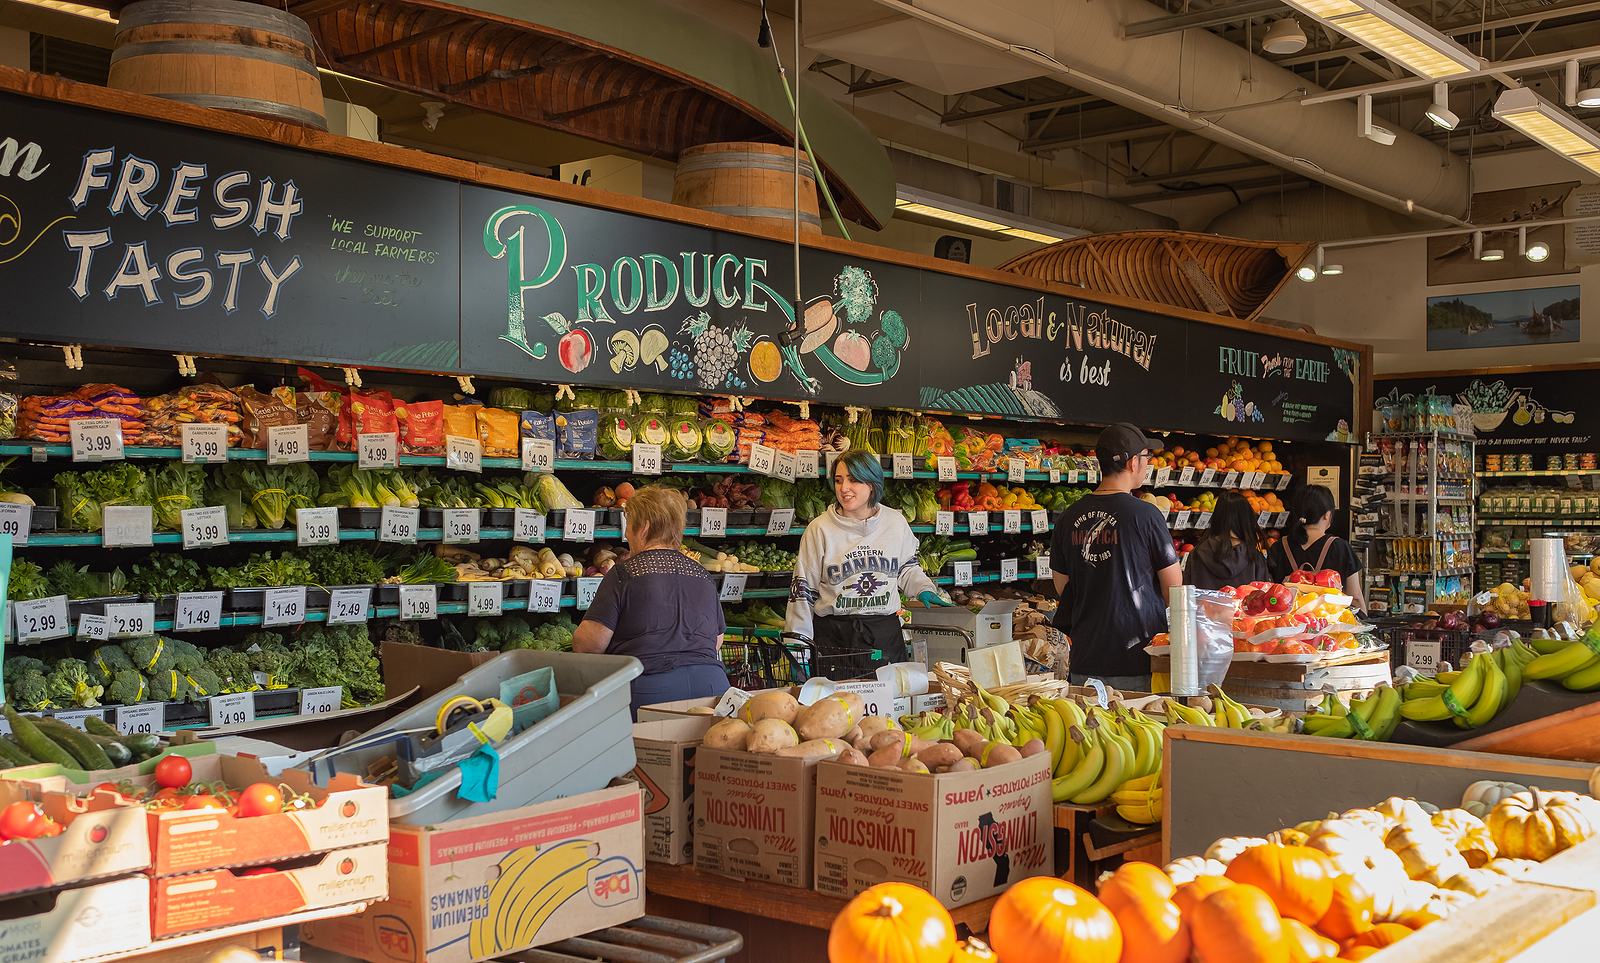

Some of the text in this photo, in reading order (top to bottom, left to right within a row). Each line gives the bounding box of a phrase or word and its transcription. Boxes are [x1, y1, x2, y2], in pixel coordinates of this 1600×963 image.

[70, 147, 303, 242] FRESH
[364, 224, 423, 243] SUPPORT
[331, 238, 369, 254] LOCAL
[63, 227, 303, 319] TASTY
[483, 204, 768, 360] PRODUCE
[965, 296, 1157, 371] Local & Natural
[1059, 355, 1111, 386] is best
[1220, 346, 1259, 378] FRUIT
[1296, 358, 1330, 383] EARTH
[81, 433, 111, 451] $3.99
[190, 438, 218, 456] $3.99
[274, 439, 299, 455] $4.99
[364, 446, 387, 461] $4.99
[453, 446, 474, 464] $4.99
[528, 451, 548, 467] $4.99
[638, 454, 656, 470] $4.99
[754, 454, 769, 470] $2.99
[778, 461, 792, 477] $2.99
[388, 519, 410, 537] $4.99
[450, 520, 471, 536] $3.99
[520, 520, 538, 537] $3.99
[569, 519, 587, 534] $2.99
[706, 517, 721, 531] $1.99
[772, 520, 786, 531] $3.99
[1073, 514, 1087, 529] KING
[1087, 511, 1096, 519] OF
[1097, 511, 1108, 519] THE
[190, 524, 219, 541] $3.99
[305, 522, 330, 539] $3.99
[844, 549, 884, 560] WESTERN
[827, 556, 900, 585] CANADA
[725, 583, 740, 596] $2.99
[407, 598, 430, 614] $1.99
[473, 594, 494, 611] $4.99
[535, 591, 554, 608] $3.99
[183, 607, 210, 624] $1.49
[272, 601, 297, 617] $1.49
[337, 601, 360, 617] $2.49
[24, 614, 56, 633] $2.99
[84, 623, 104, 636] $2.99
[114, 615, 143, 633] $2.99
[1411, 652, 1433, 665] $2.99
[697, 771, 797, 792] SWEET POTATOES yams
[945, 767, 1051, 806] SWEET POTATOES yams
[726, 788, 765, 805] Organic
[820, 786, 929, 812] SWEET POTATOES yams
[998, 793, 1031, 814] Organic
[582, 814, 609, 828] BANANAS
[610, 808, 635, 823] PREMIUM
[706, 797, 786, 834] LIVINGSTON
[853, 806, 895, 824] Organic
[320, 817, 378, 835] millennium
[515, 823, 577, 843] PREMIUM BANANAS
[954, 821, 969, 830] BRAND
[763, 834, 797, 853] Miss
[829, 814, 916, 856] LIVINGSTON
[957, 810, 1037, 866] LIVINGSTON
[62, 841, 135, 862] millennium
[437, 836, 508, 858] PREMIUM BANANAS
[779, 861, 793, 870] JUMBO
[1013, 843, 1047, 870] Miss
[776, 869, 793, 877] MEDIUM
[824, 861, 842, 871] ORIENTALS
[829, 870, 842, 879] SWEETS
[891, 856, 927, 878] Miss
[317, 874, 375, 892] millennium
[594, 873, 630, 900] Dole
[431, 884, 490, 910] BANANAS
[433, 903, 490, 930] PREMIUM
[380, 930, 409, 954] Dole
[4, 947, 49, 963] GRAPPE
